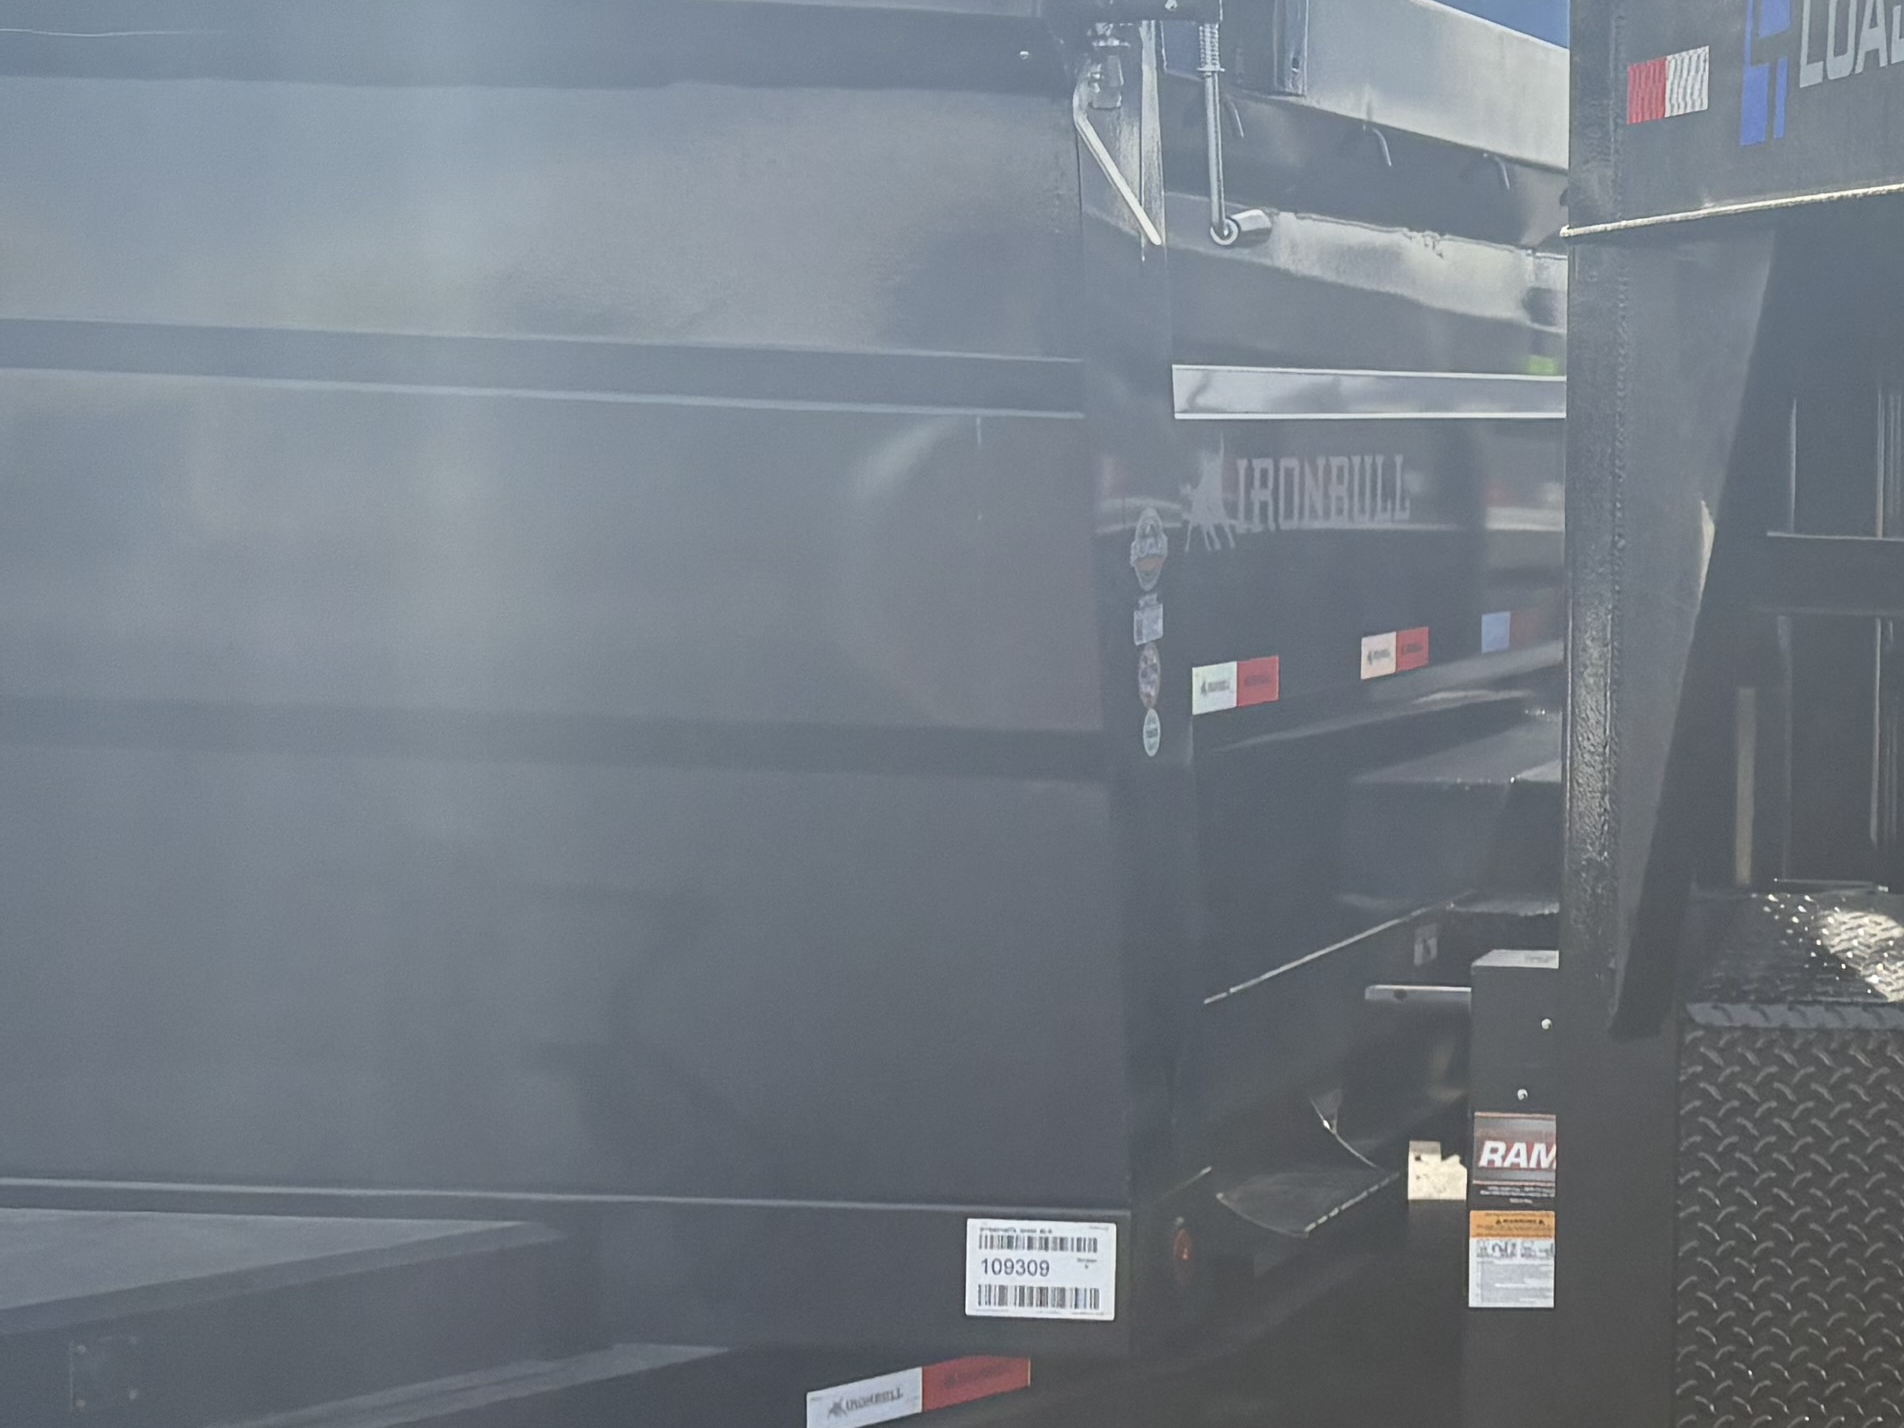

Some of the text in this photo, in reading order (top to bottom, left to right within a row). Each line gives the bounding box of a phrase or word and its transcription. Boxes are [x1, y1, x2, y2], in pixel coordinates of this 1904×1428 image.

[1235, 454, 1411, 533] IRONBULL
[1479, 1140, 1556, 1169] RAM
[981, 1257, 1050, 1277] 109309
